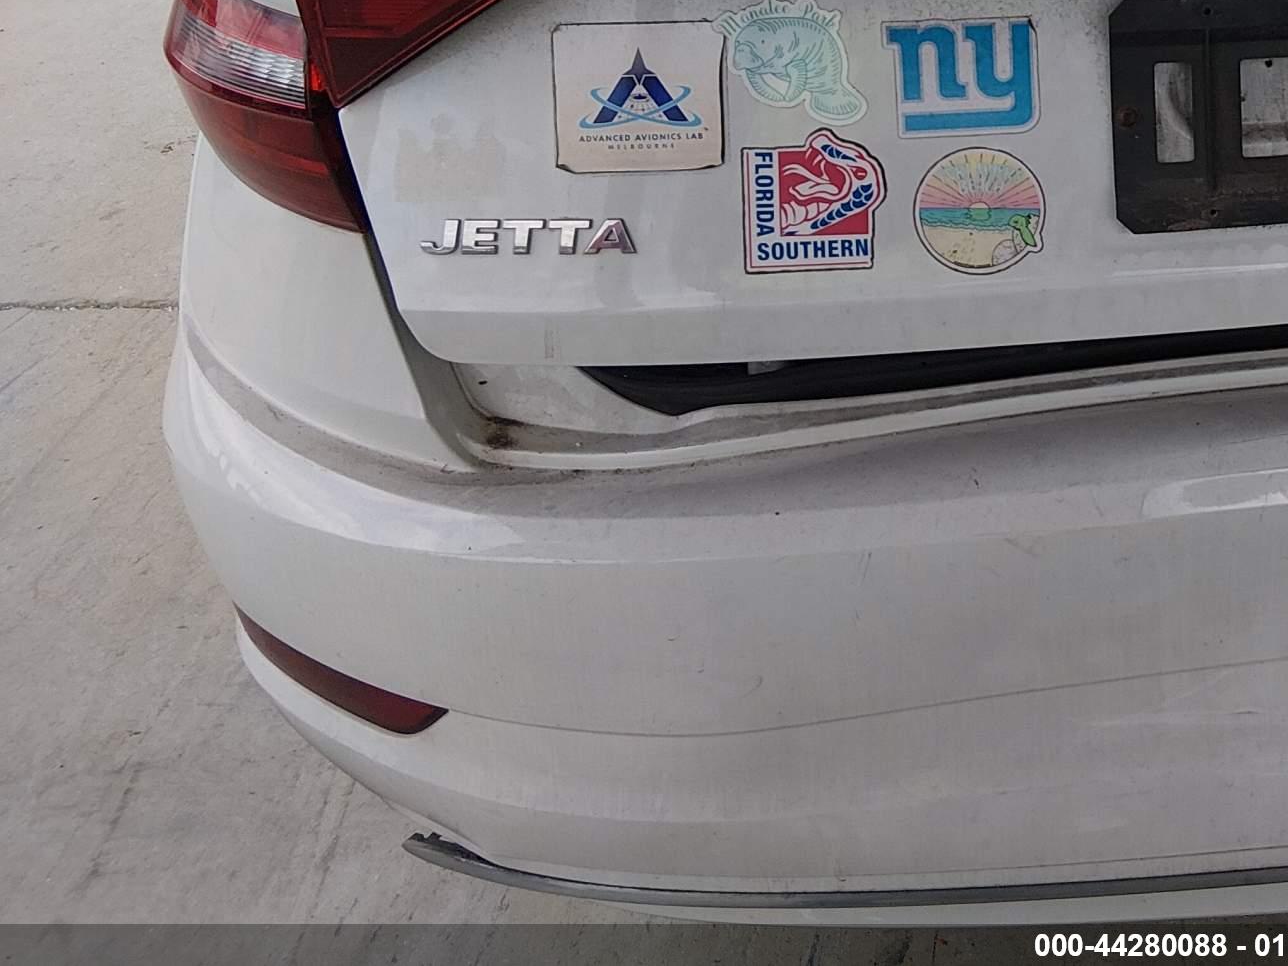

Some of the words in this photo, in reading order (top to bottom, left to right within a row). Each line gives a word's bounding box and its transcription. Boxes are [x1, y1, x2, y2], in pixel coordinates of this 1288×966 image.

[800, 3, 837, 27] Park
[579, 134, 631, 142] ADVANCED
[635, 133, 682, 141] AVIONICS
[754, 152, 775, 237] FLORIDA
[419, 218, 637, 255] JETTA
[757, 238, 869, 261] SOUTHERN
